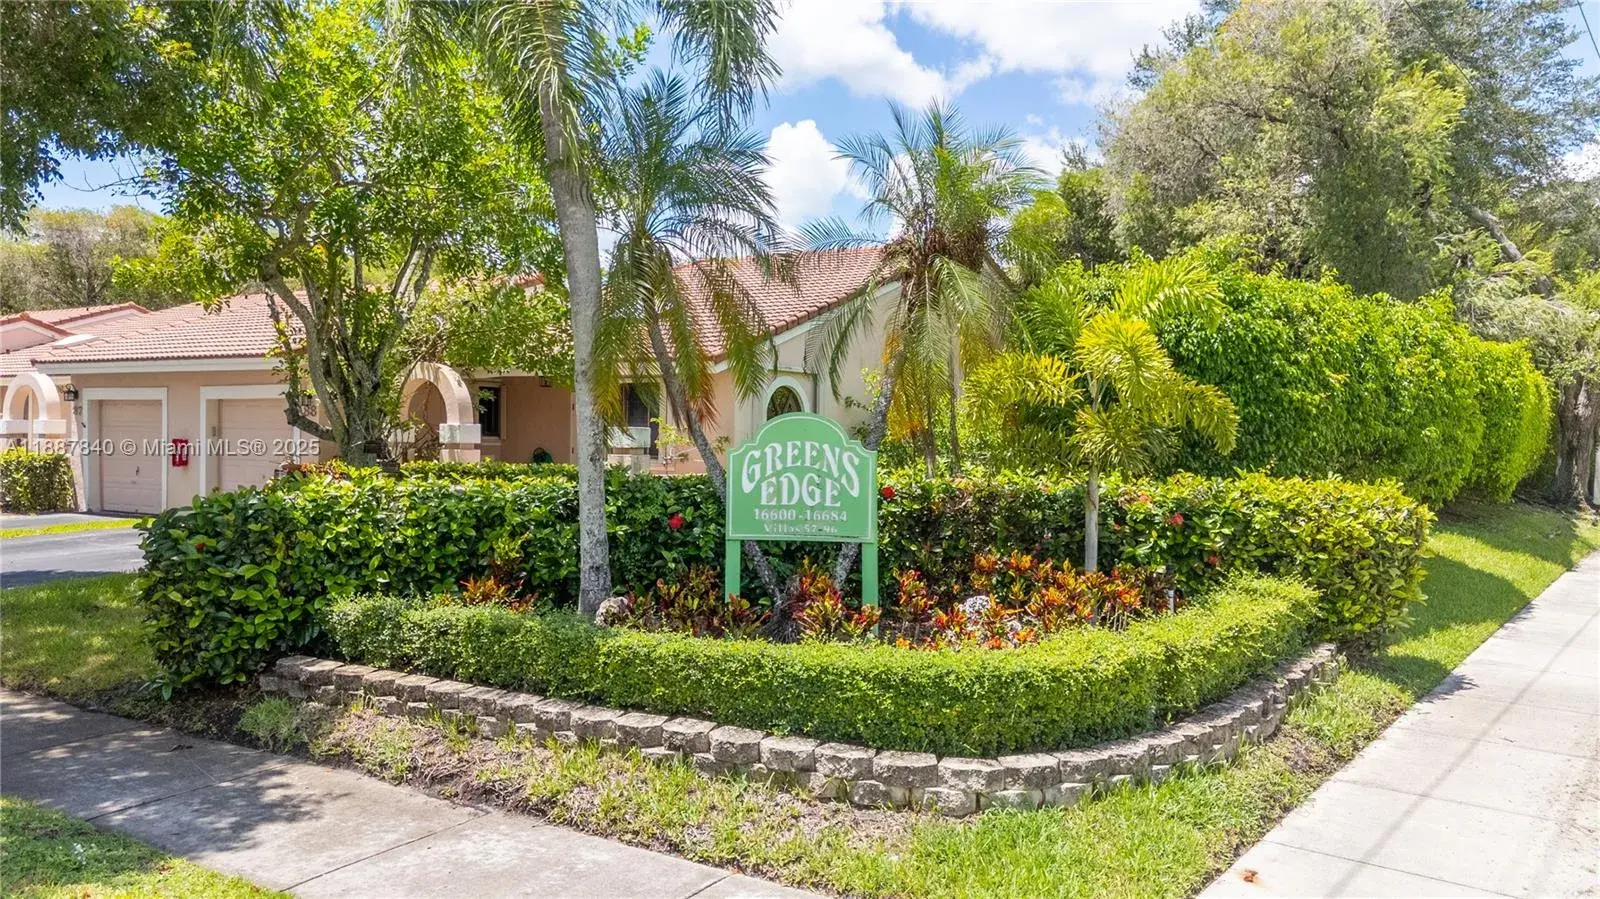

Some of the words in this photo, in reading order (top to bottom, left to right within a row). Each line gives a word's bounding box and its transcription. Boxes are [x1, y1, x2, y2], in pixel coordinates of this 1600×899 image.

[741, 440, 860, 498] GREENS
[760, 472, 841, 508] EDGE
[763, 523, 801, 533] Villas
